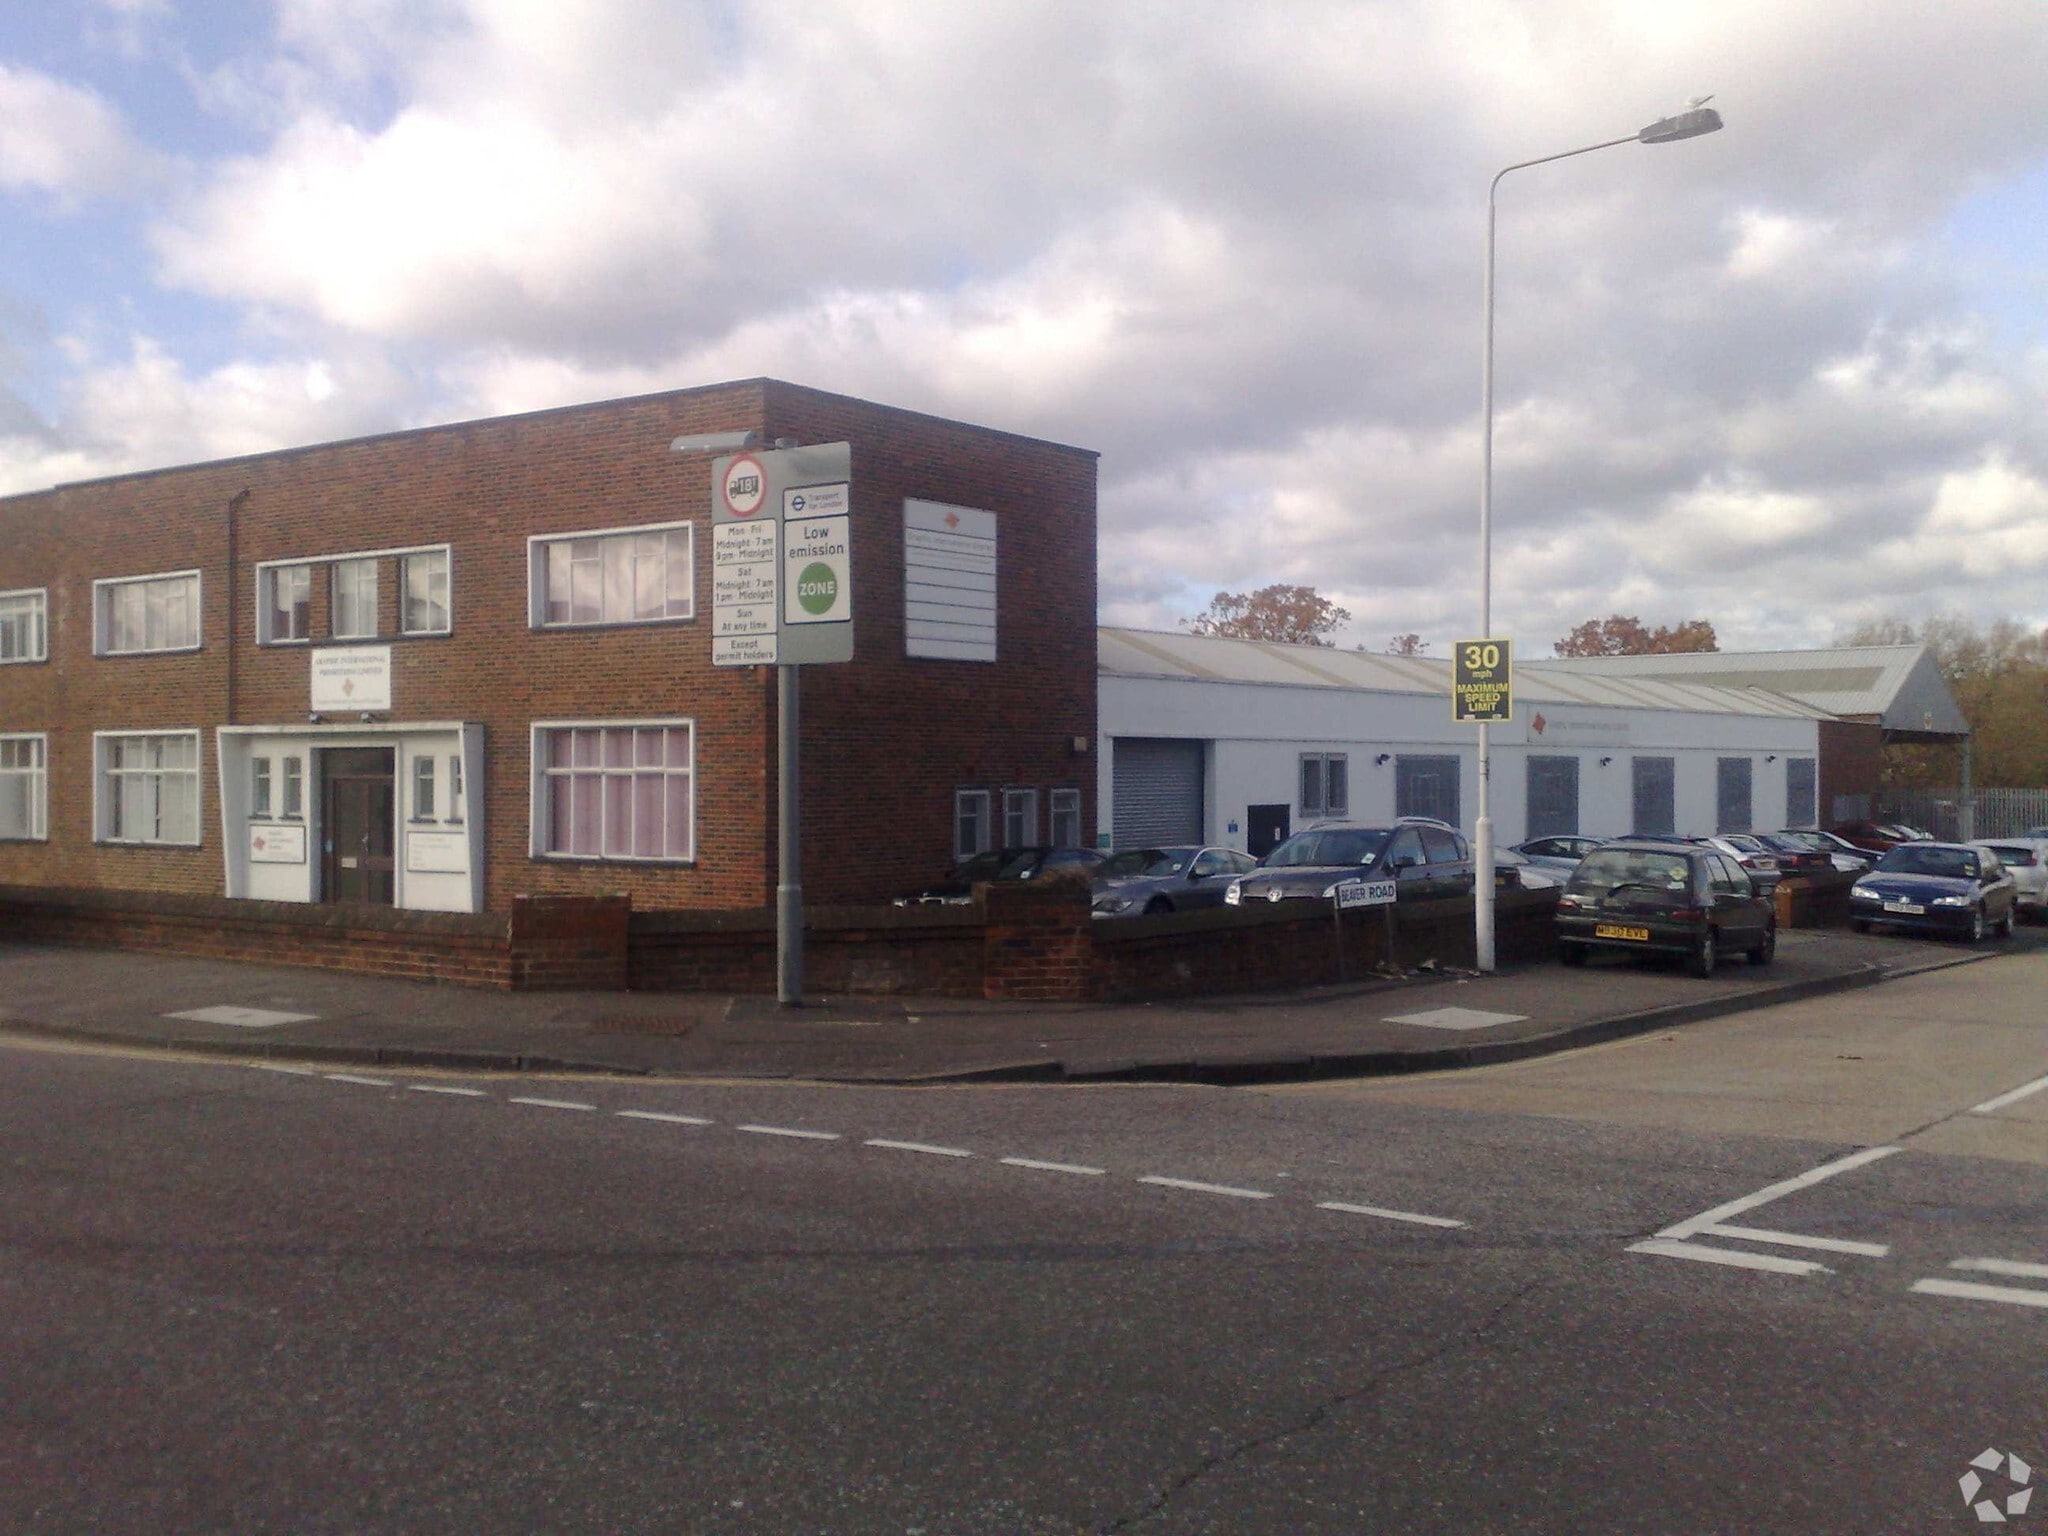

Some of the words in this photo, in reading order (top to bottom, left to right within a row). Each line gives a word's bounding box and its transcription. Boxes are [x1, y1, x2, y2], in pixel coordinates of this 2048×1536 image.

[808, 492, 839, 501] Transport
[728, 527, 745, 536] Mon
[751, 525, 761, 534] Fri
[804, 526, 829, 540] Low
[716, 539, 750, 550] Midnight
[739, 548, 774, 559] Midnight
[789, 542, 844, 559] emission
[737, 568, 752, 577] Sat
[716, 580, 750, 590] Midnight
[799, 580, 836, 596] ZONE
[738, 589, 774, 600] Midnight
[737, 609, 752, 618] Sun
[721, 622, 731, 631] At
[734, 623, 748, 632] any
[749, 621, 767, 630] time
[730, 639, 758, 649] Except
[1465, 645, 1500, 669] 30
[1472, 669, 1493, 680] mph
[1457, 682, 1509, 694] MAXIMUM
[1465, 692, 1501, 702] SPEED
[1468, 702, 1497, 712] LIMIT
[1341, 887, 1366, 902] BEAVER
[1369, 885, 1395, 899] ROAD
